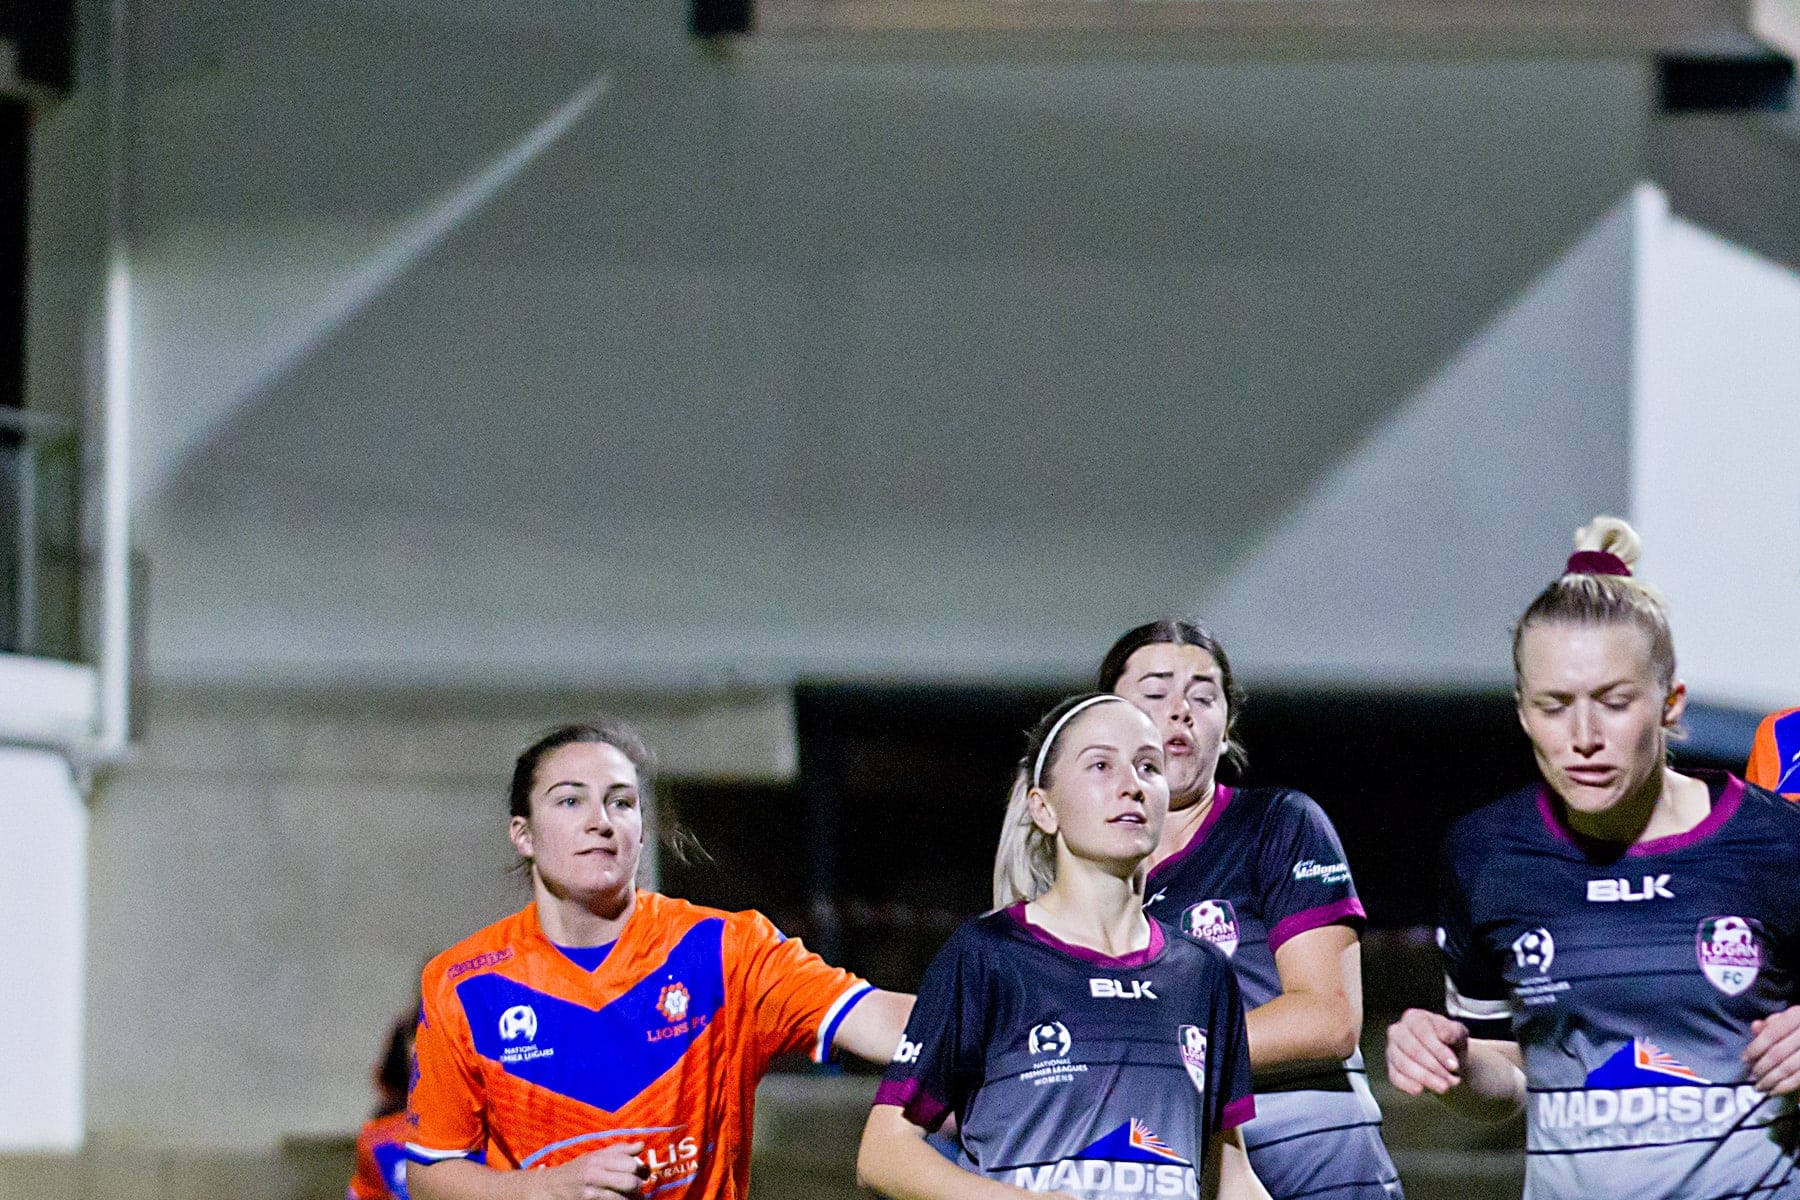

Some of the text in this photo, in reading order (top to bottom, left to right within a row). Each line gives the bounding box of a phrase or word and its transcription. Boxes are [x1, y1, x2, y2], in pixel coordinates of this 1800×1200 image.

[1586, 874, 1676, 901] BLK
[1184, 921, 1235, 938] OGAN
[1702, 942, 1760, 957] LOGAN
[1723, 971, 1743, 985] FC
[1089, 978, 1158, 999] BLK
[647, 1022, 689, 1041] LIONS
[1033, 1058, 1071, 1069] NATIONAL
